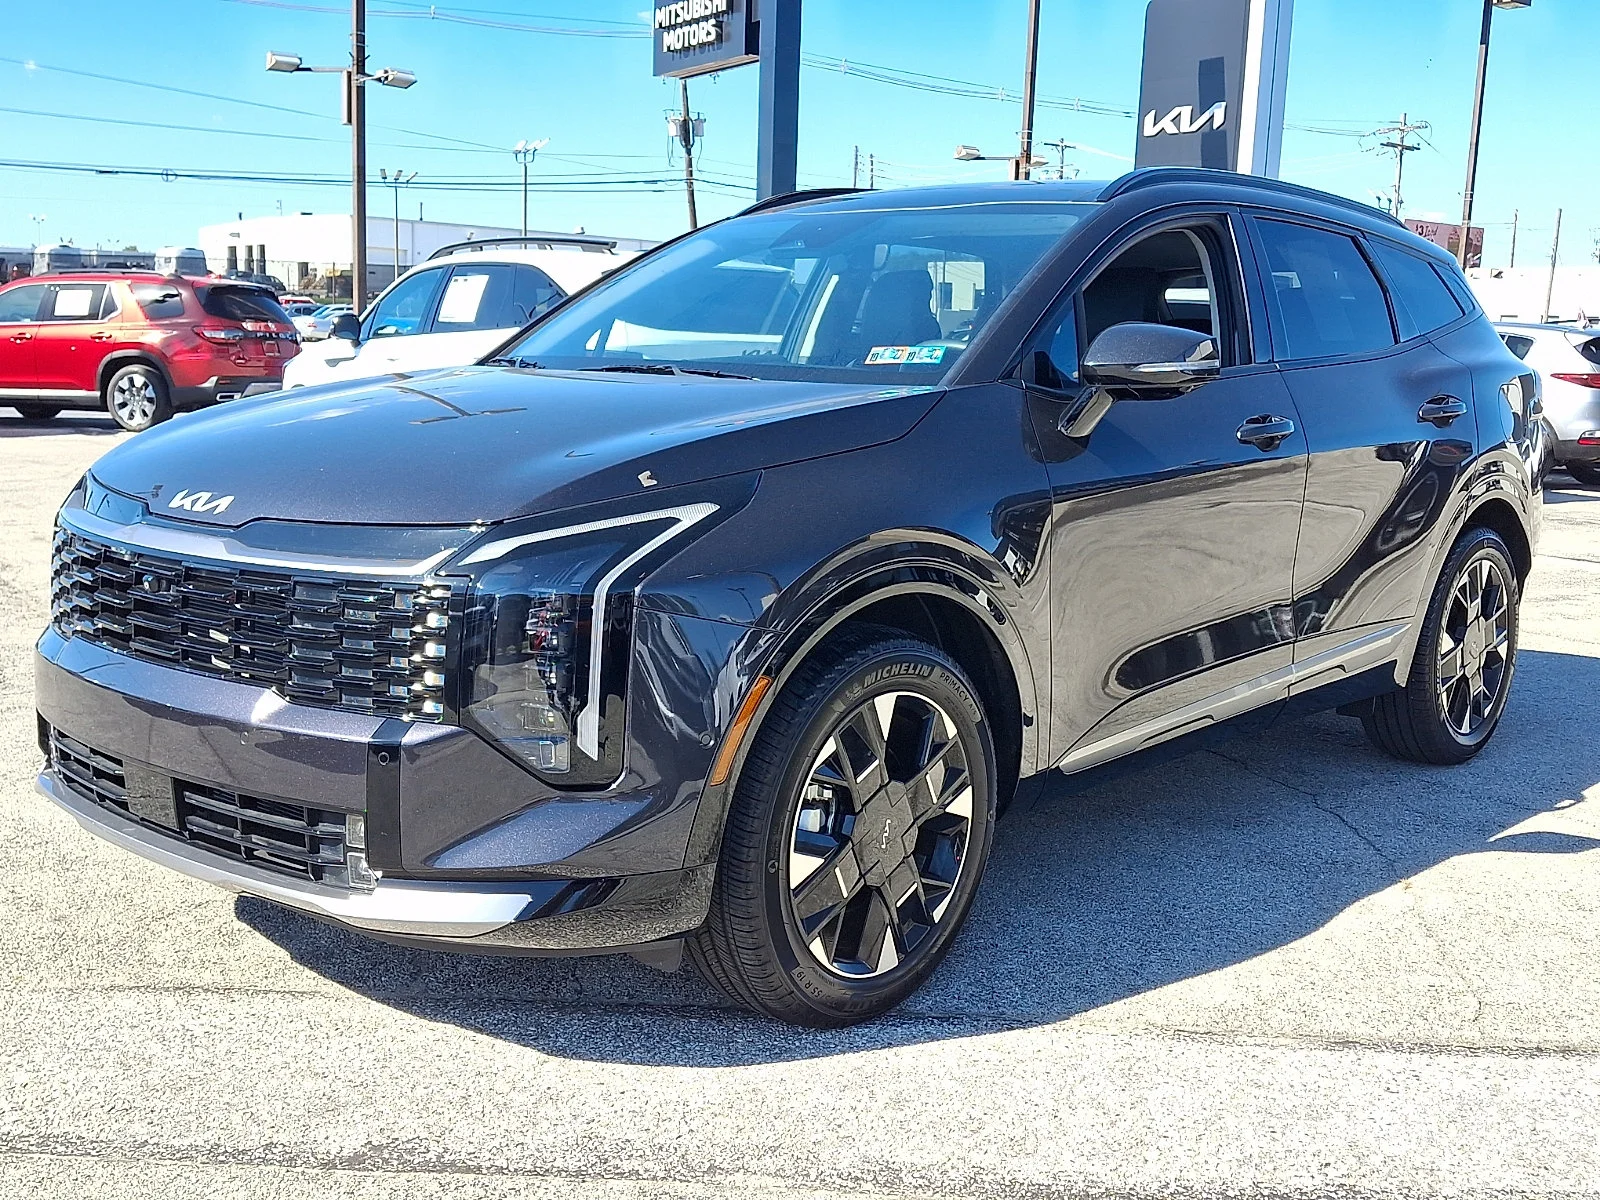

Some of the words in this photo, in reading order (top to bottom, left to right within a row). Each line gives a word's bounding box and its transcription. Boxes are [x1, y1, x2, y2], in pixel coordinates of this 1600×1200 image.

[663, 19, 716, 52] MOTORS
[1143, 101, 1227, 137] KIA
[168, 489, 235, 515] KIA
[864, 662, 931, 688] MICHELIN
[939, 672, 969, 702] PRIMACY
